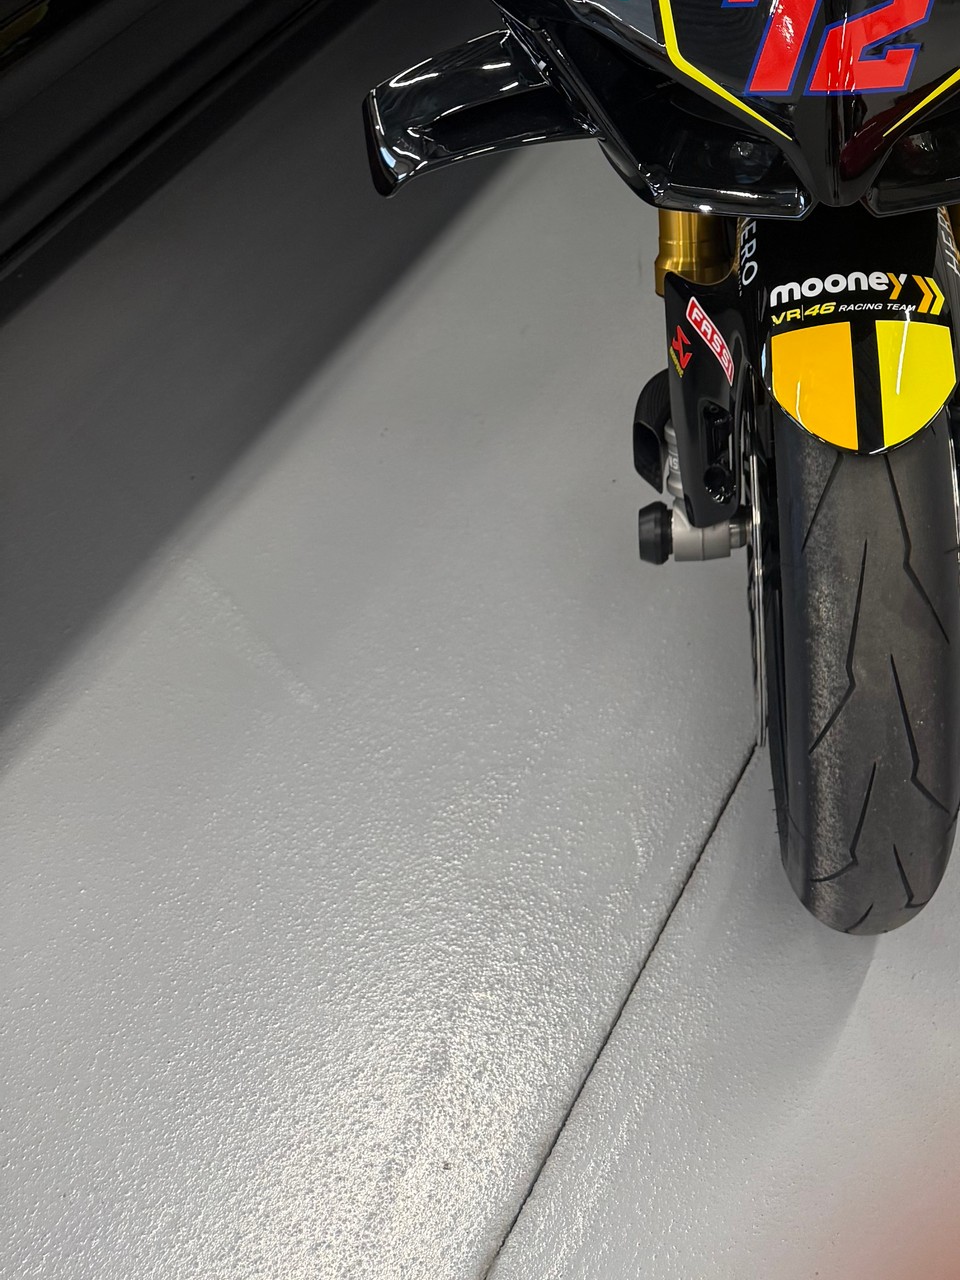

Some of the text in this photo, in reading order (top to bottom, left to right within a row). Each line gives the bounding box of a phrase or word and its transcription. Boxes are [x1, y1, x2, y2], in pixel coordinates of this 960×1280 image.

[770, 271, 907, 308] mooney
[838, 303, 883, 312] RACING
[886, 303, 916, 312] TEAM
[691, 307, 733, 376] FASSI
